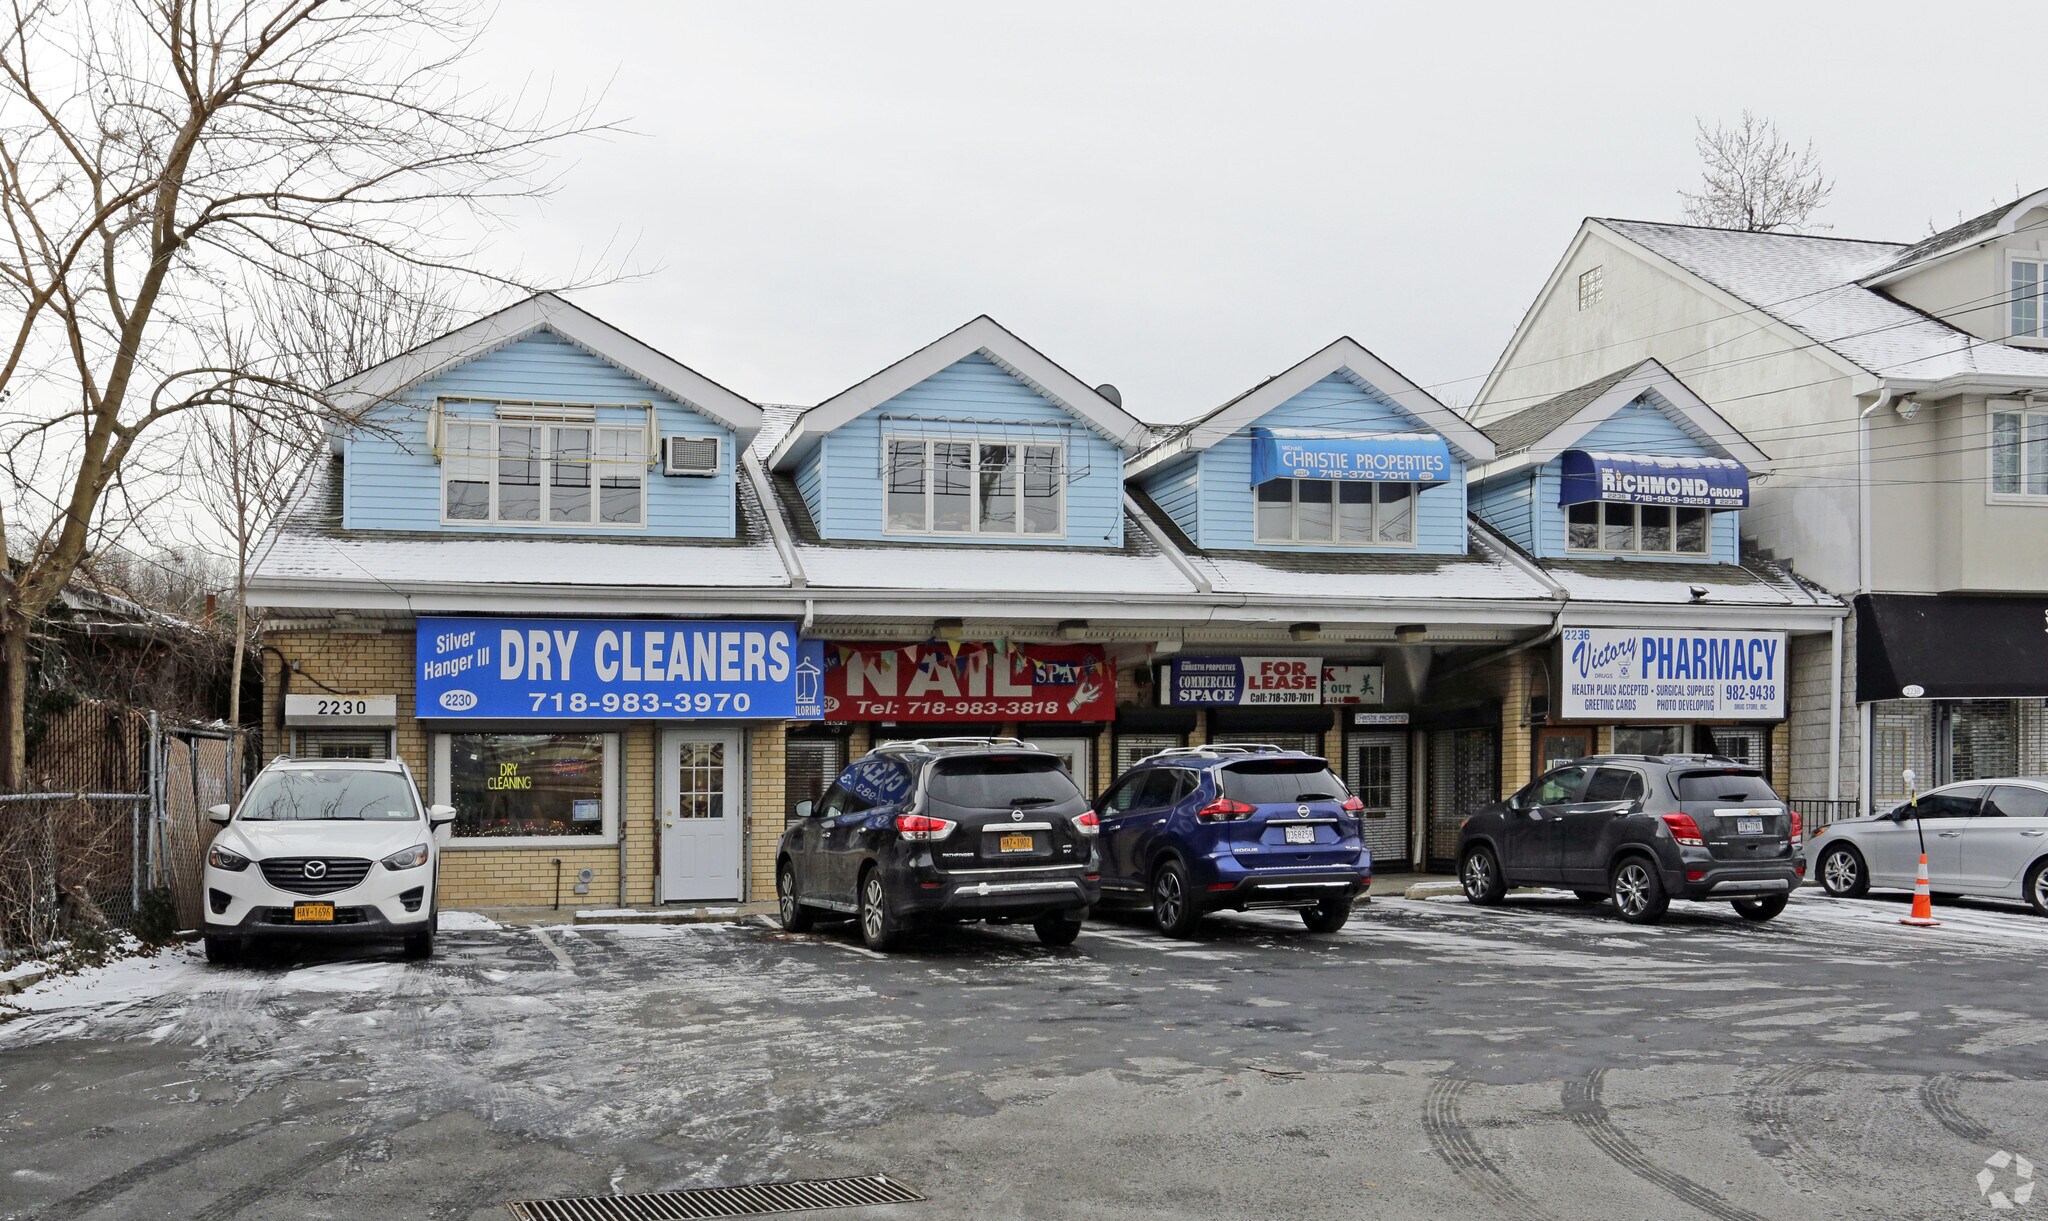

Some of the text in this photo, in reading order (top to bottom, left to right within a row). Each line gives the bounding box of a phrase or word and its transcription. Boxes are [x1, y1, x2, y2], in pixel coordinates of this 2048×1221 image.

[1282, 451, 1444, 471] CHRISTIE PROPERTIES
[1319, 469, 1410, 480] 718-370-7011
[1634, 494, 1711, 505] 718-983-9258
[1709, 487, 1743, 498] GROUP
[1564, 629, 1591, 640] 2236
[436, 631, 475, 654] Silver
[500, 629, 790, 682] DRY CLEANERS
[1572, 637, 1778, 681] Victory PHARMACY
[424, 655, 473, 680] Hanger
[846, 651, 1074, 697] NAIL SPA
[1260, 662, 1307, 675] FOR
[1180, 676, 1235, 688] COMMERCIAL
[1248, 676, 1317, 690] LEASE
[1331, 684, 1352, 694] OUT
[1360, 673, 1375, 696] 美
[1180, 689, 1234, 702] SPACE
[1250, 693, 1314, 703] Call: 718-370-7011
[1571, 684, 1775, 701] HEALTH PLANS ACCEPTED SURGICAL SUPPLIES 982-9438
[445, 694, 471, 706] 2230
[528, 692, 750, 713] 718-983-3970
[1584, 699, 1714, 711] GREETING CARDS PHOTO DEVELOPING
[318, 700, 366, 715] 2230
[857, 701, 1058, 715] Tel: 718-983-3818
[500, 763, 518, 777] DRY
[487, 776, 532, 790] CLEANING
